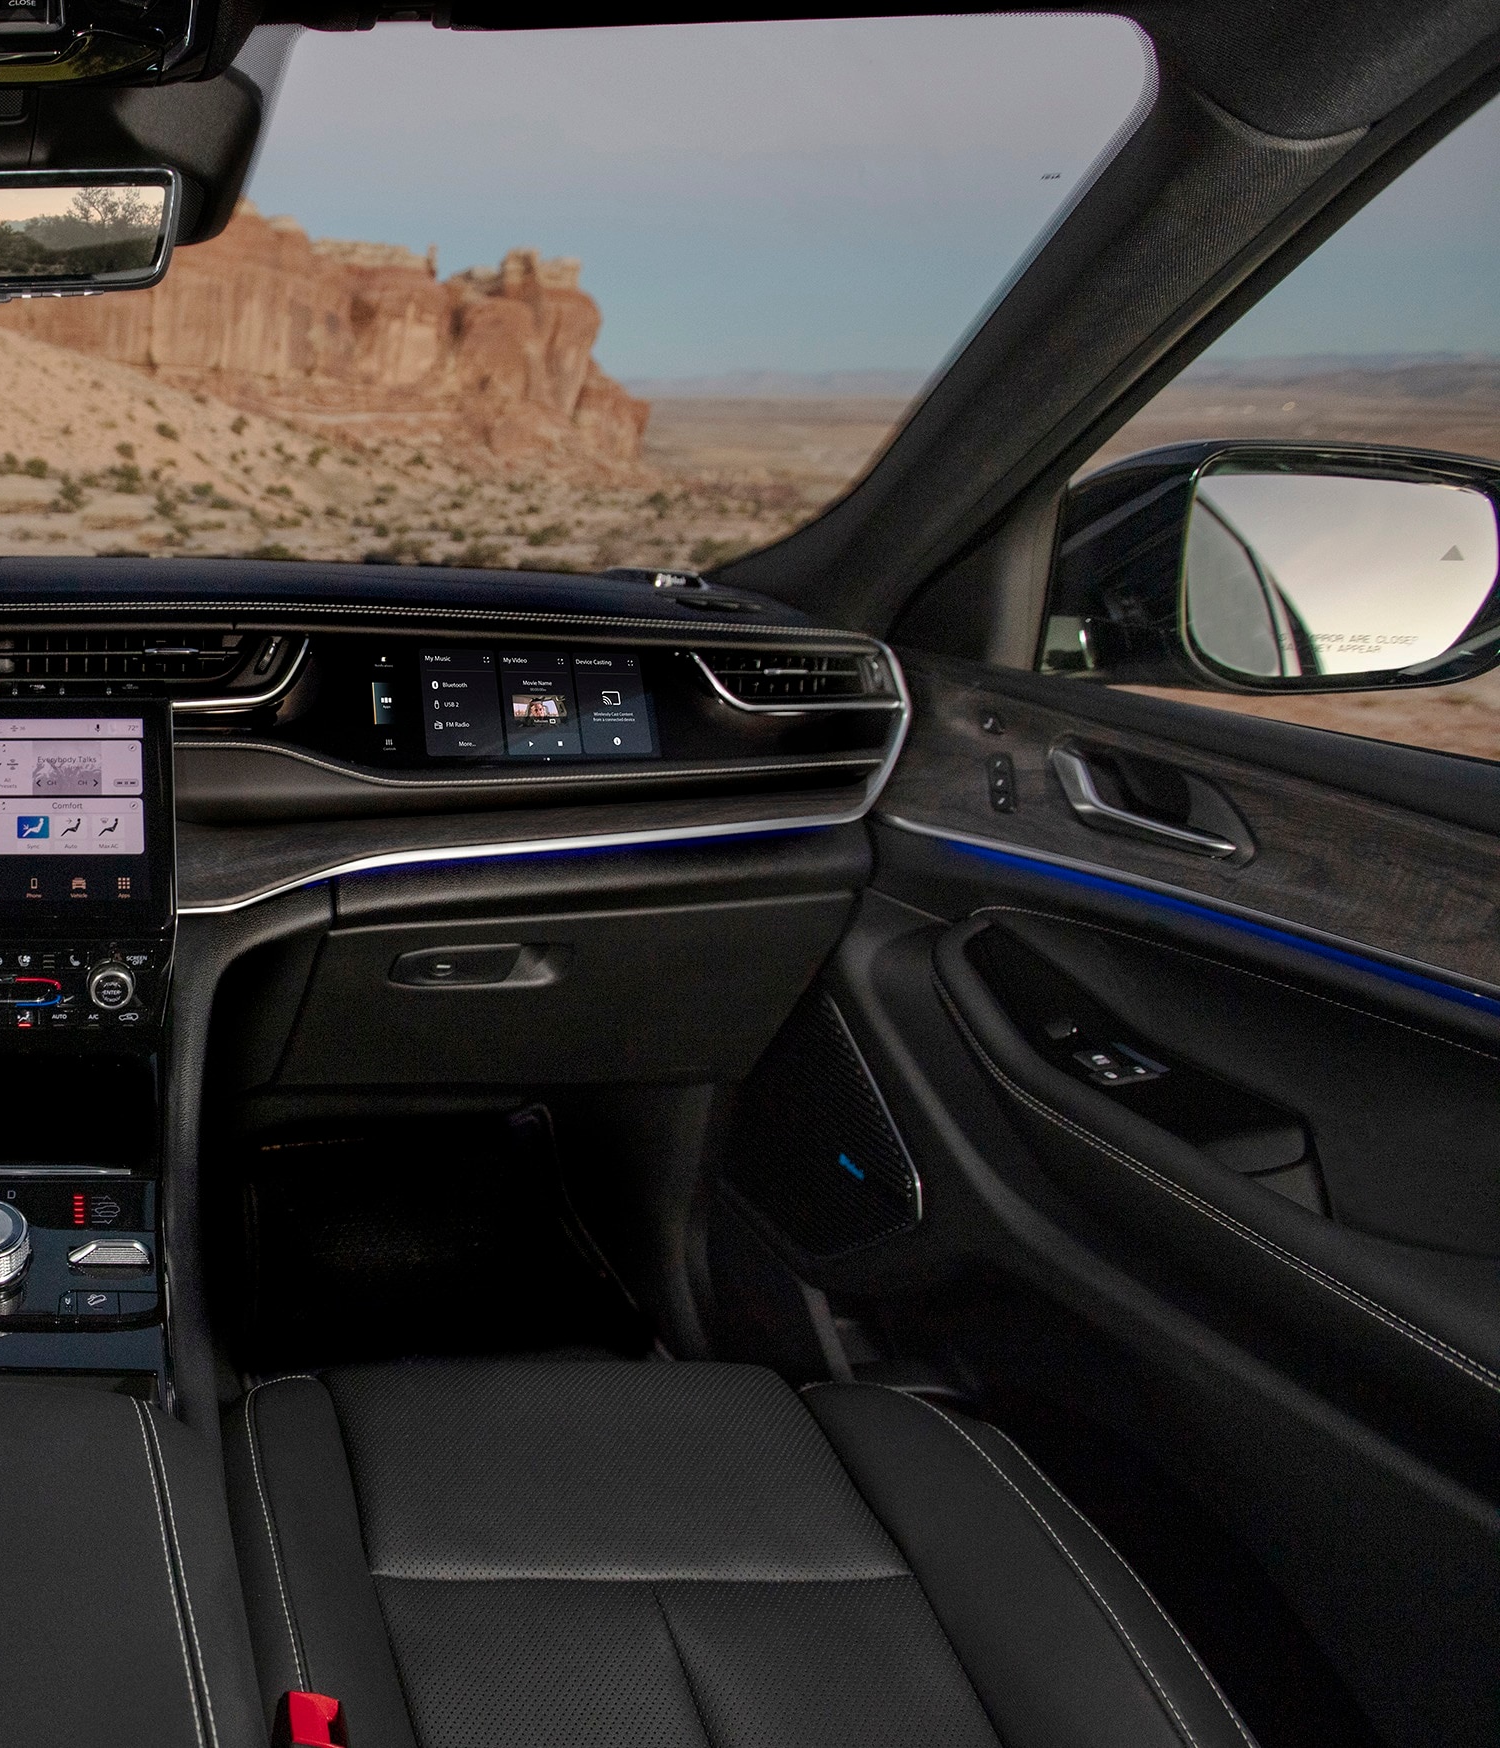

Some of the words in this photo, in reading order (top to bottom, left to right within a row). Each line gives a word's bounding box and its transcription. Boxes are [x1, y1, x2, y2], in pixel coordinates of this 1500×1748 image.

[1349, 634, 1371, 643] ARE
[1336, 644, 1382, 654] APPEAR
[424, 655, 434, 663] My
[593, 659, 612, 667] Casting
[37, 756, 77, 764] Everybody
[51, 801, 83, 810] Comfort
[7, 1190, 16, 1199] D
